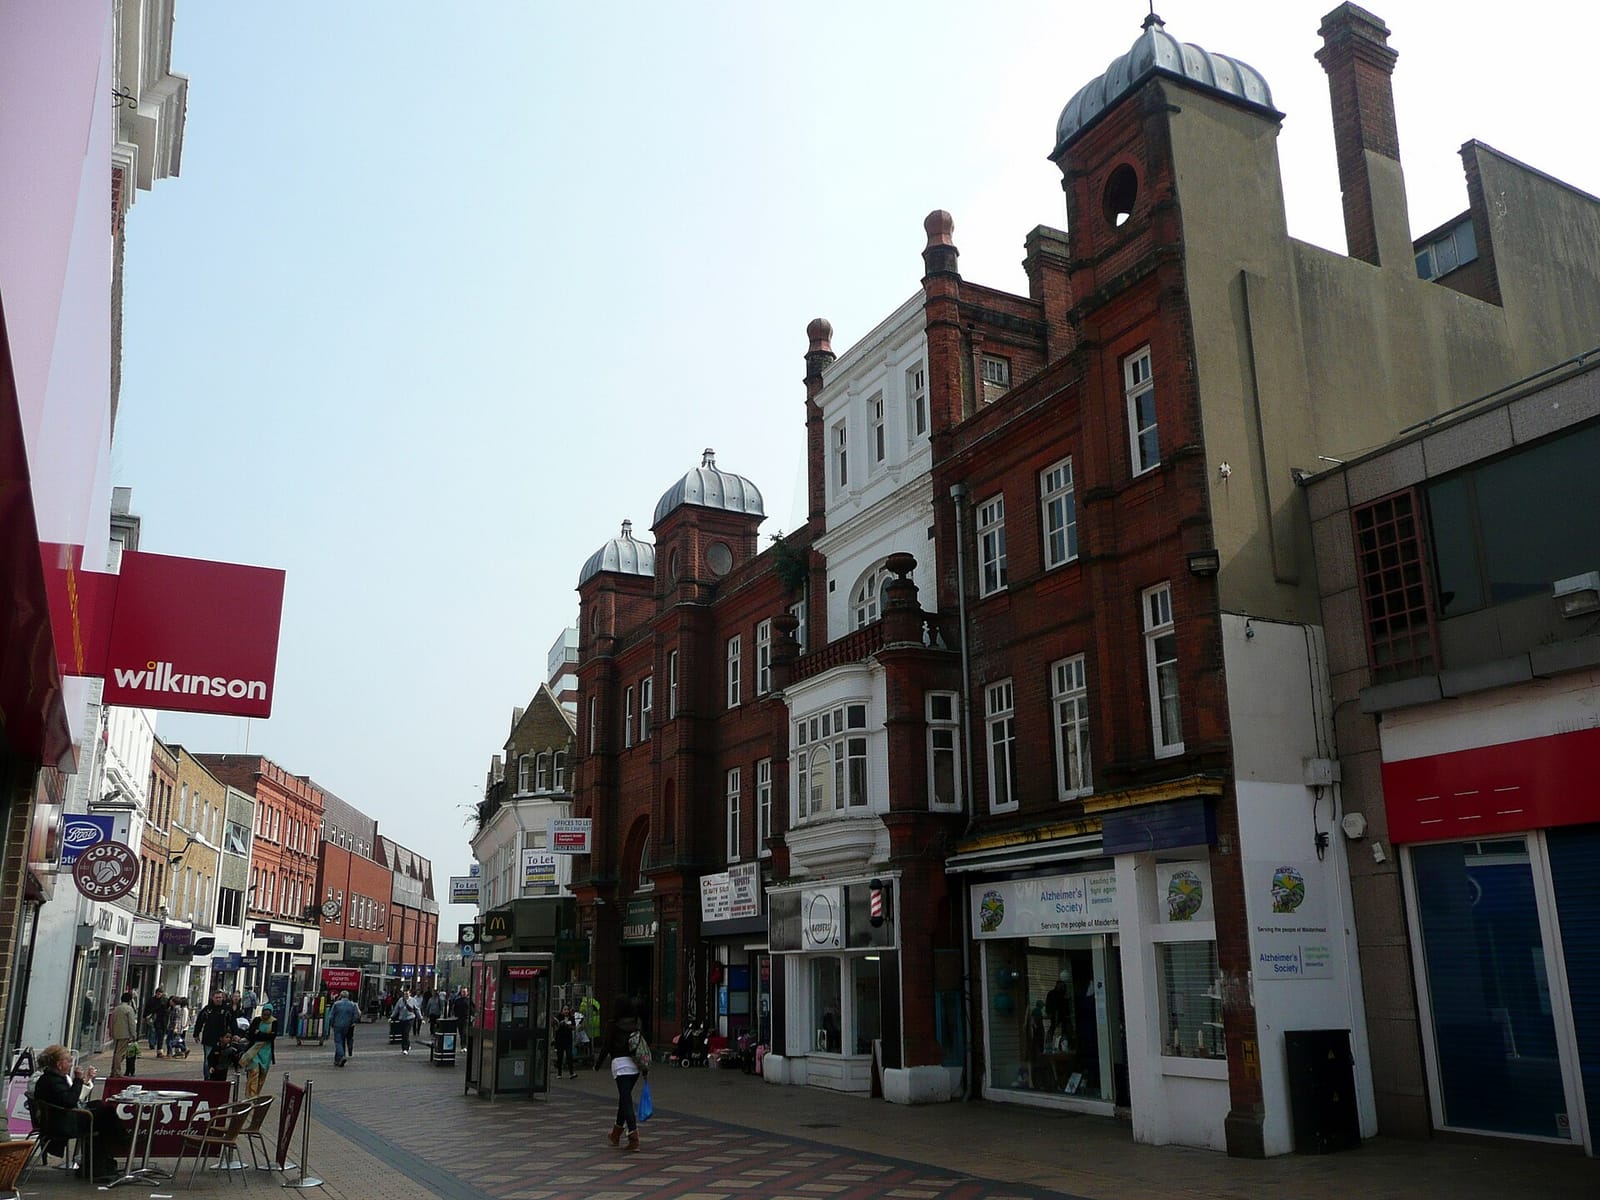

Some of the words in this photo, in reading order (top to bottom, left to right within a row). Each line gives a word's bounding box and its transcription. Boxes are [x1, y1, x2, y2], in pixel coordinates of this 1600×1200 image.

[114, 661, 267, 700] wilkinson
[67, 827, 97, 843] Boots
[87, 846, 128, 862] COSTA
[528, 856, 538, 864] To
[541, 855, 554, 864] Let
[81, 875, 129, 895] COFFEE
[1040, 888, 1082, 903] Alzheimer's
[1056, 902, 1083, 914] Society
[1041, 922, 1060, 930] Serving
[1069, 920, 1087, 929] people
[1257, 926, 1274, 934] Serving
[462, 926, 475, 942] 3
[1260, 952, 1298, 962] Alzheimer's
[1274, 964, 1299, 974] Society
